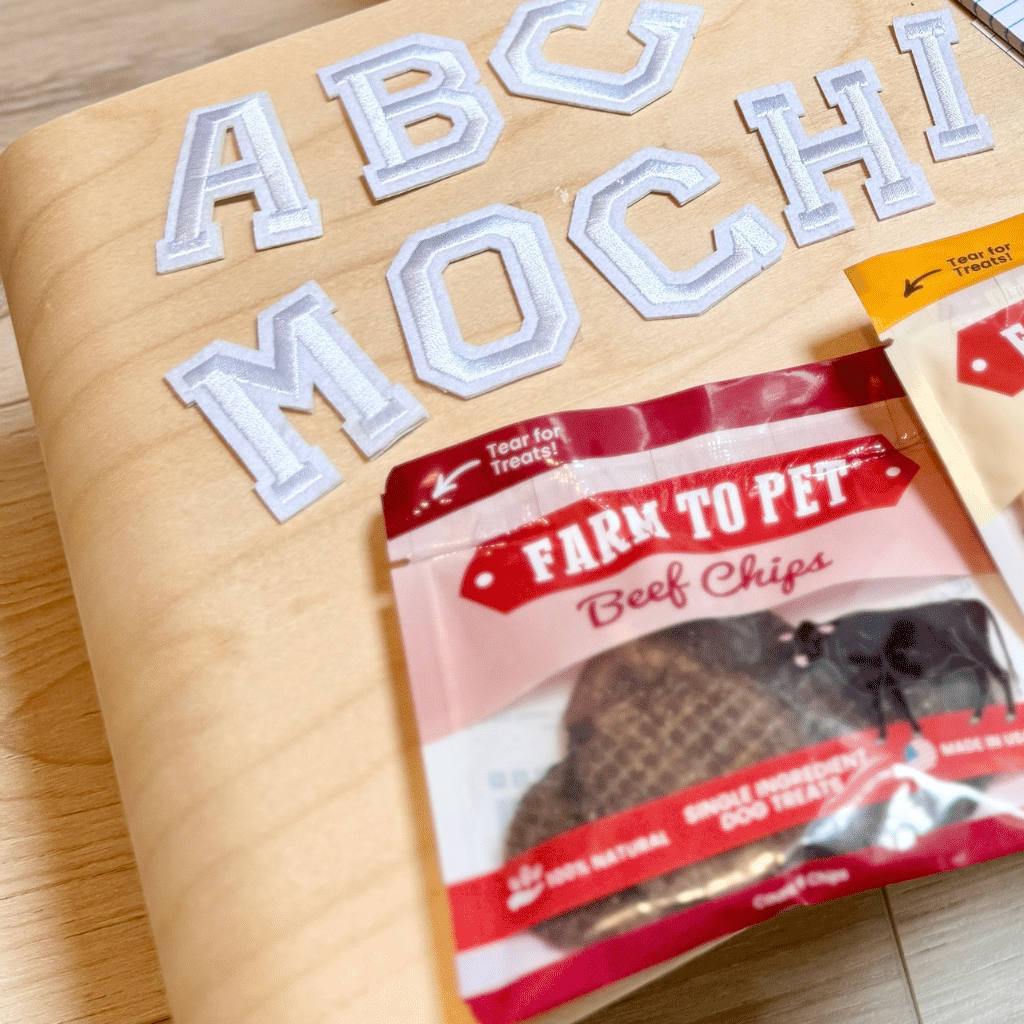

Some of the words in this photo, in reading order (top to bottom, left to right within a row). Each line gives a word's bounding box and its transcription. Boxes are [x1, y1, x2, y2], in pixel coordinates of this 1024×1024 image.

[946, 251, 984, 267] Tear
[987, 243, 1011, 255] for
[952, 252, 1013, 277] Treats!
[485, 434, 530, 459] Tear
[532, 426, 561, 443] for
[490, 441, 558, 476] Treats!
[522, 498, 671, 584] FARM
[675, 480, 746, 540] TO
[575, 560, 691, 629] Beef
[700, 551, 834, 597] Chips
[940, 736, 983, 756] MADE
